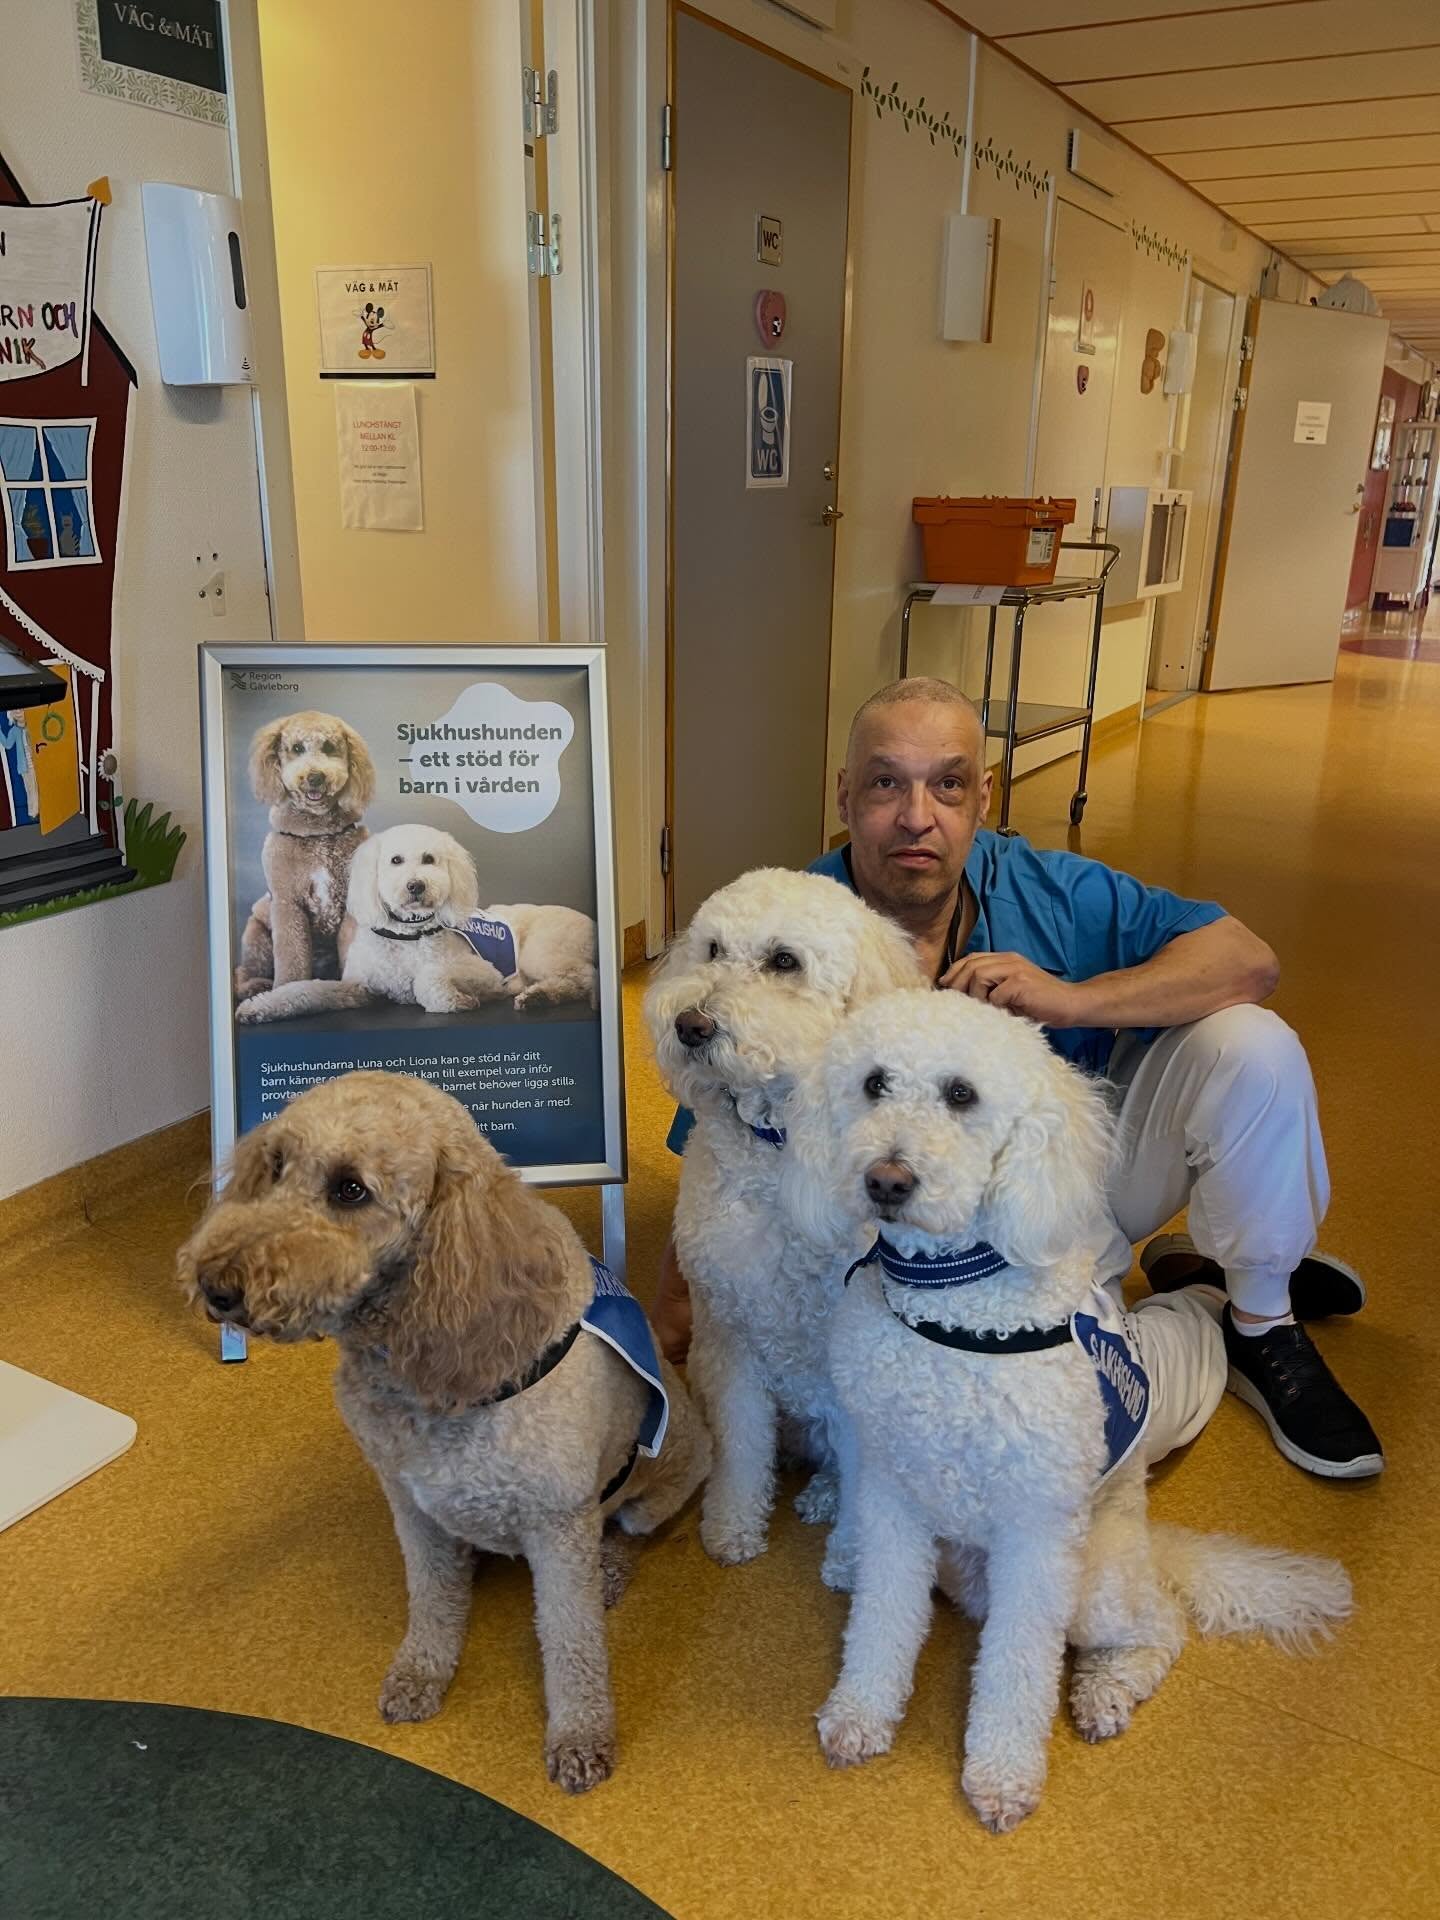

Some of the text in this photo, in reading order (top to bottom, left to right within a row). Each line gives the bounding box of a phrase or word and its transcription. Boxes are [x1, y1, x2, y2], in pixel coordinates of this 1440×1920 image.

[114, 2, 214, 49] VÄG & MÄT
[762, 230, 779, 250] WC
[345, 280, 399, 293] VÄG & MÄT
[41, 301, 79, 338] OCH
[757, 449, 778, 471] WC
[249, 672, 281, 682] Region
[249, 681, 299, 692] Gävleborg
[397, 723, 562, 745] Sjukhushunden
[420, 751, 450, 767] ett
[456, 750, 503, 767] stöd
[509, 750, 540, 767] för
[399, 777, 540, 794] barn i vården
[261, 1051, 541, 1074] Sjukhushundarna Luna och Liona kan ge stöd när ditt
[261, 1077, 286, 1087] barn
[289, 1075, 326, 1085] känner
[420, 1069, 440, 1079] kan
[442, 1068, 456, 1078] till
[457, 1066, 502, 1079] exempel
[504, 1066, 526, 1075] vara
[528, 1064, 552, 1074] inför
[443, 1082, 477, 1092] barnet
[479, 1079, 521, 1090] behöver
[524, 1078, 549, 1089] ligga
[551, 1076, 577, 1087] stilla.
[472, 1101, 489, 1111] när
[491, 1099, 531, 1110] hunden
[534, 1098, 545, 1108] är
[547, 1097, 573, 1107] med.
[491, 1121, 517, 1131] barn.
